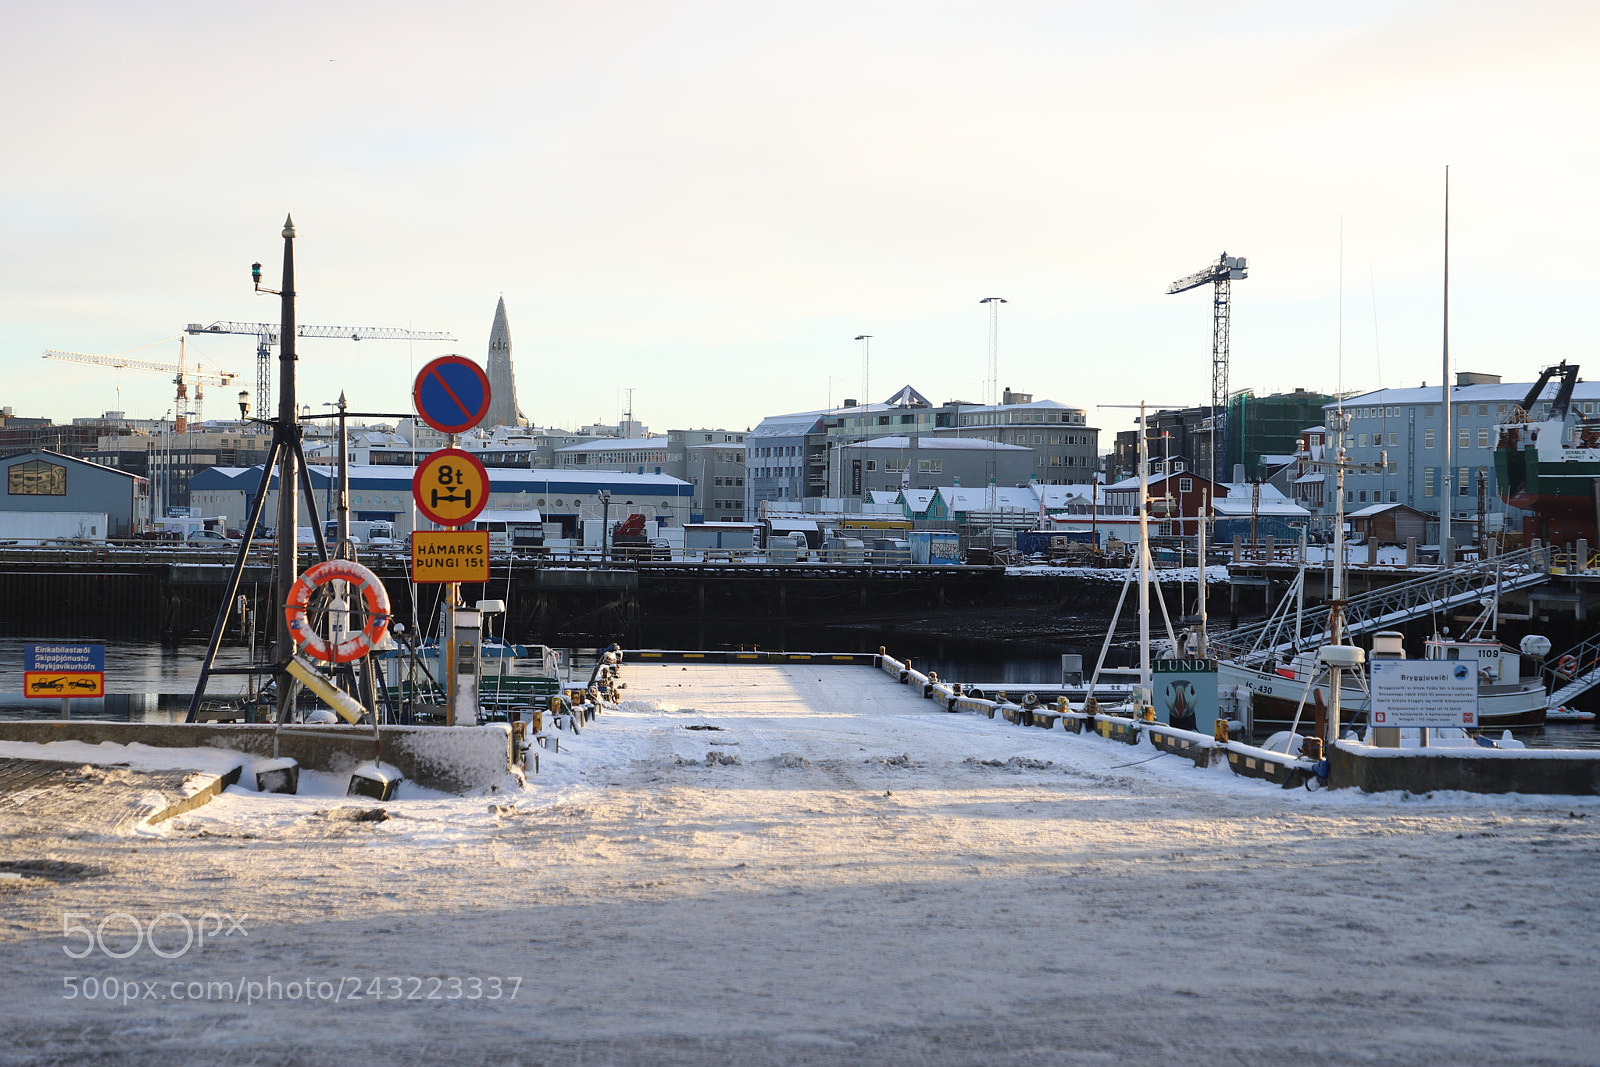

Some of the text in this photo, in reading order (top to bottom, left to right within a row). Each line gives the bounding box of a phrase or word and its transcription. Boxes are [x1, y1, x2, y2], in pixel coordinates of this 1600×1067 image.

[438, 465, 463, 485] 8t
[418, 543, 483, 555] HÁMARKS
[416, 558, 484, 568] ÞUNGI 15t
[1478, 649, 1499, 658] 1109
[1157, 660, 1212, 672] LUNDI
